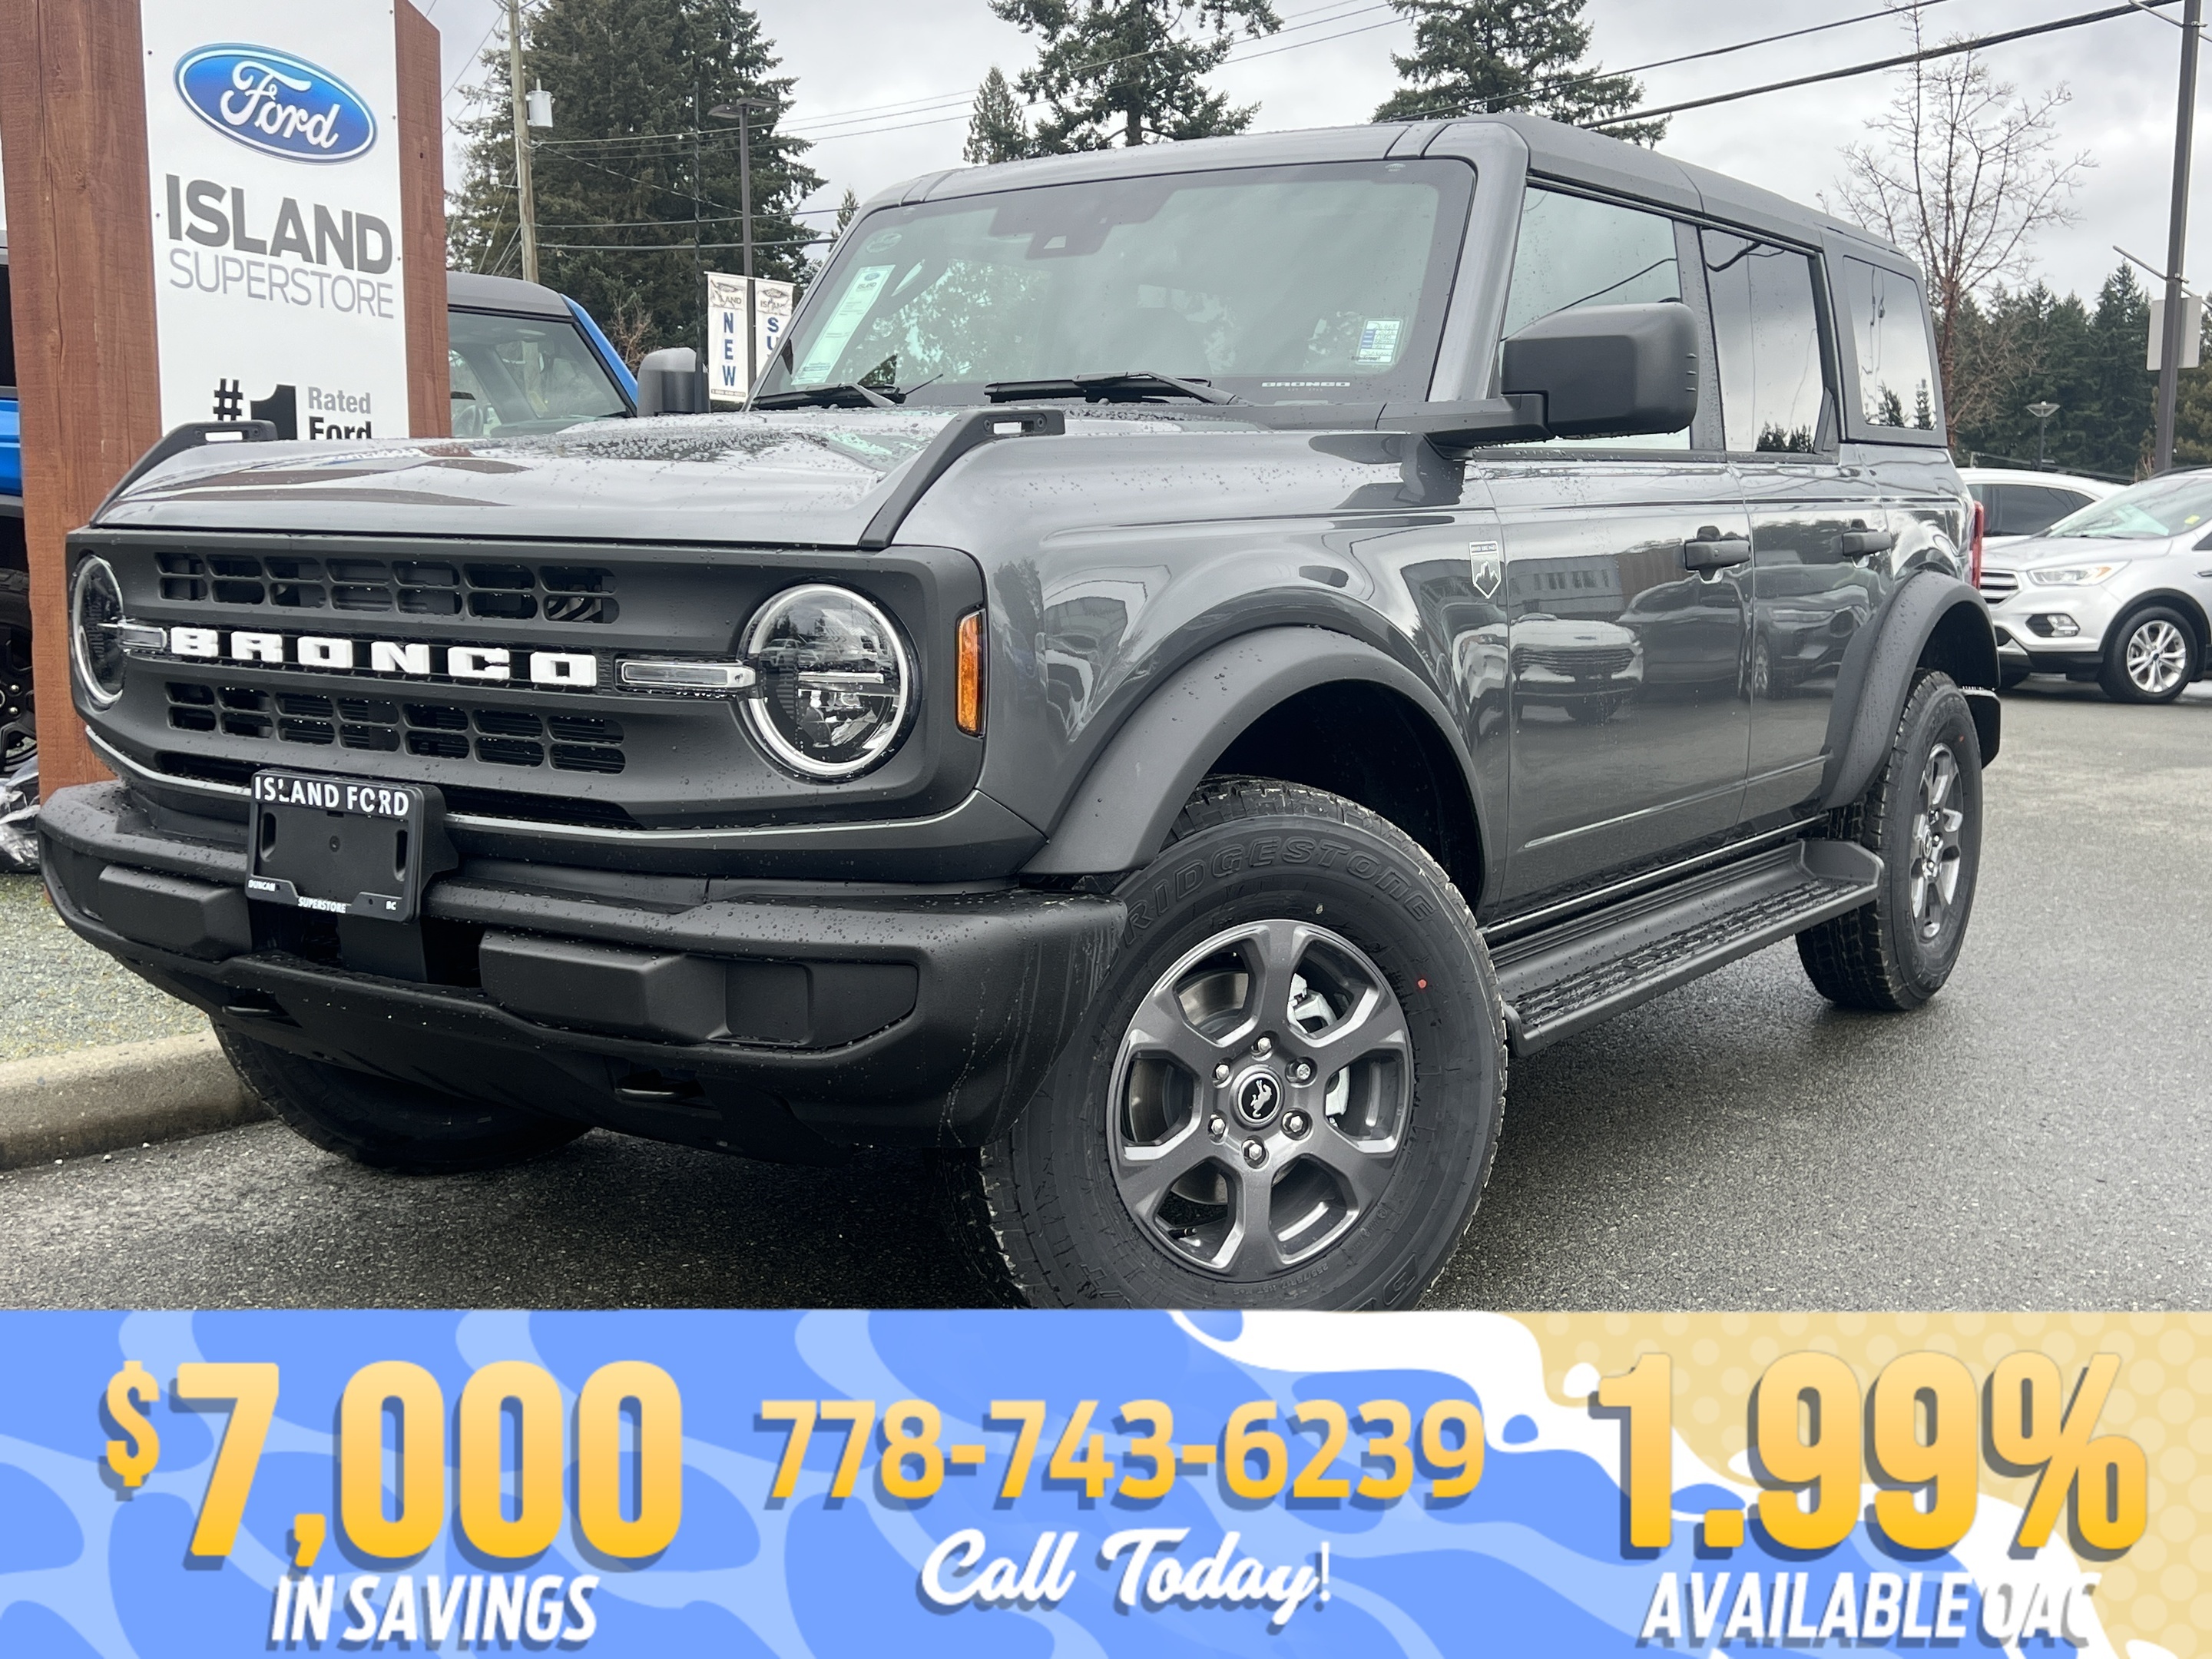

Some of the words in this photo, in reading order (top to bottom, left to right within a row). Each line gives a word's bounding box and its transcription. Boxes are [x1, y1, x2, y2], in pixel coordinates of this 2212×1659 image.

[220, 60, 340, 148] Ford
[166, 174, 392, 274] ISLAND
[170, 248, 394, 319] SUPERSTORE
[722, 312, 736, 386] NEW
[308, 387, 371, 414] Rated
[310, 416, 372, 440] Ford
[170, 626, 597, 687] BRONCO
[254, 777, 339, 808] ISLAND
[347, 786, 409, 816] FORD
[248, 879, 276, 892] DUNCAN
[298, 896, 346, 913] SUPERSTORE
[386, 901, 397, 911] BC
[1112, 834, 1435, 964] RIDGESTONE
